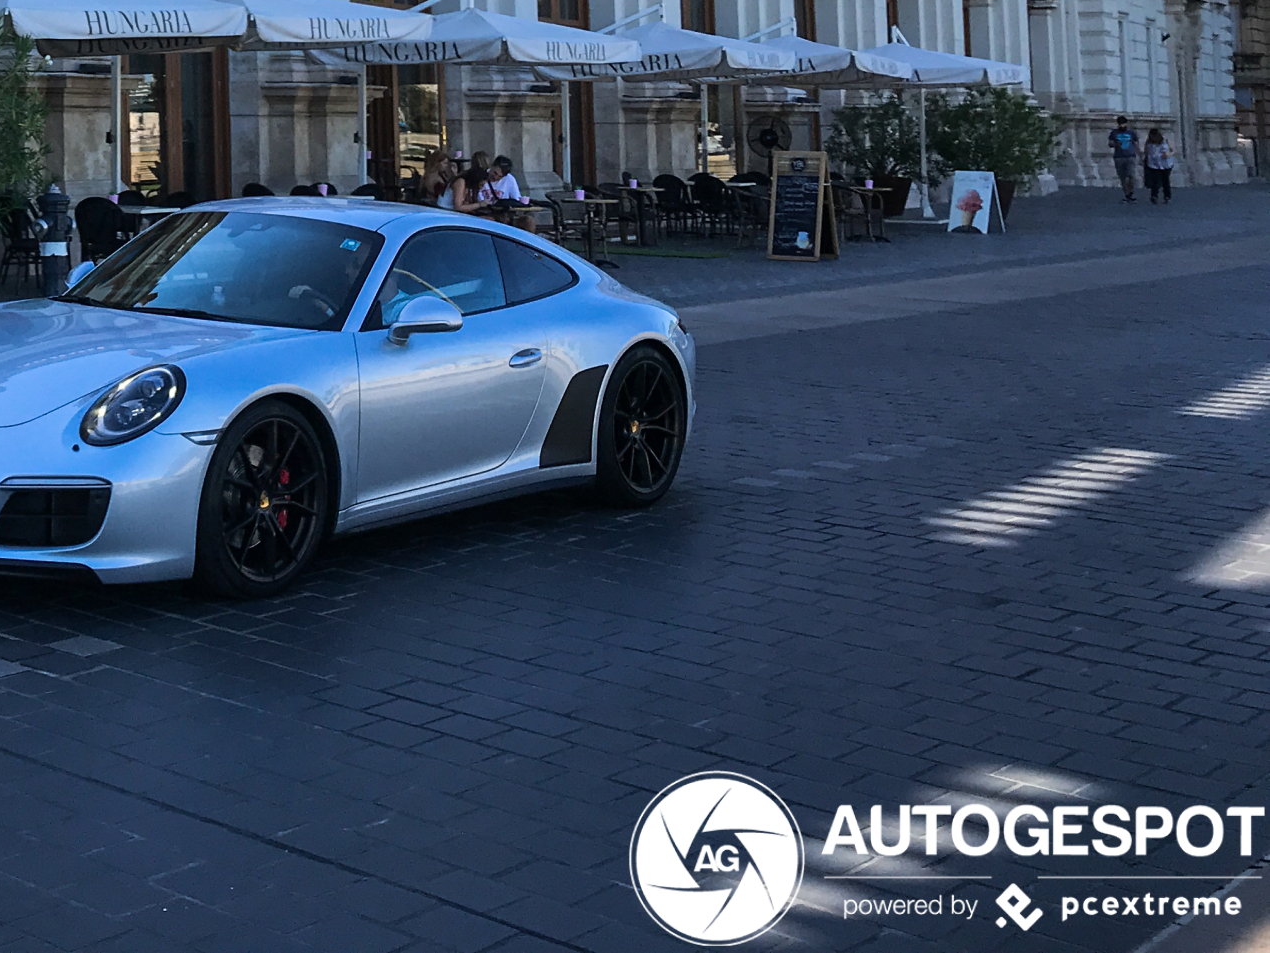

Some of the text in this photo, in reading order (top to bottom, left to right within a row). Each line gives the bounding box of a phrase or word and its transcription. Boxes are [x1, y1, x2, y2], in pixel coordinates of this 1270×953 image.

[84, 9, 193, 36] HUNGARIA
[308, 17, 391, 40] HUNGARIA
[344, 41, 463, 63] HUNGARIA
[546, 41, 607, 62] HUNGARIA
[571, 53, 685, 78] HUNGARIA
